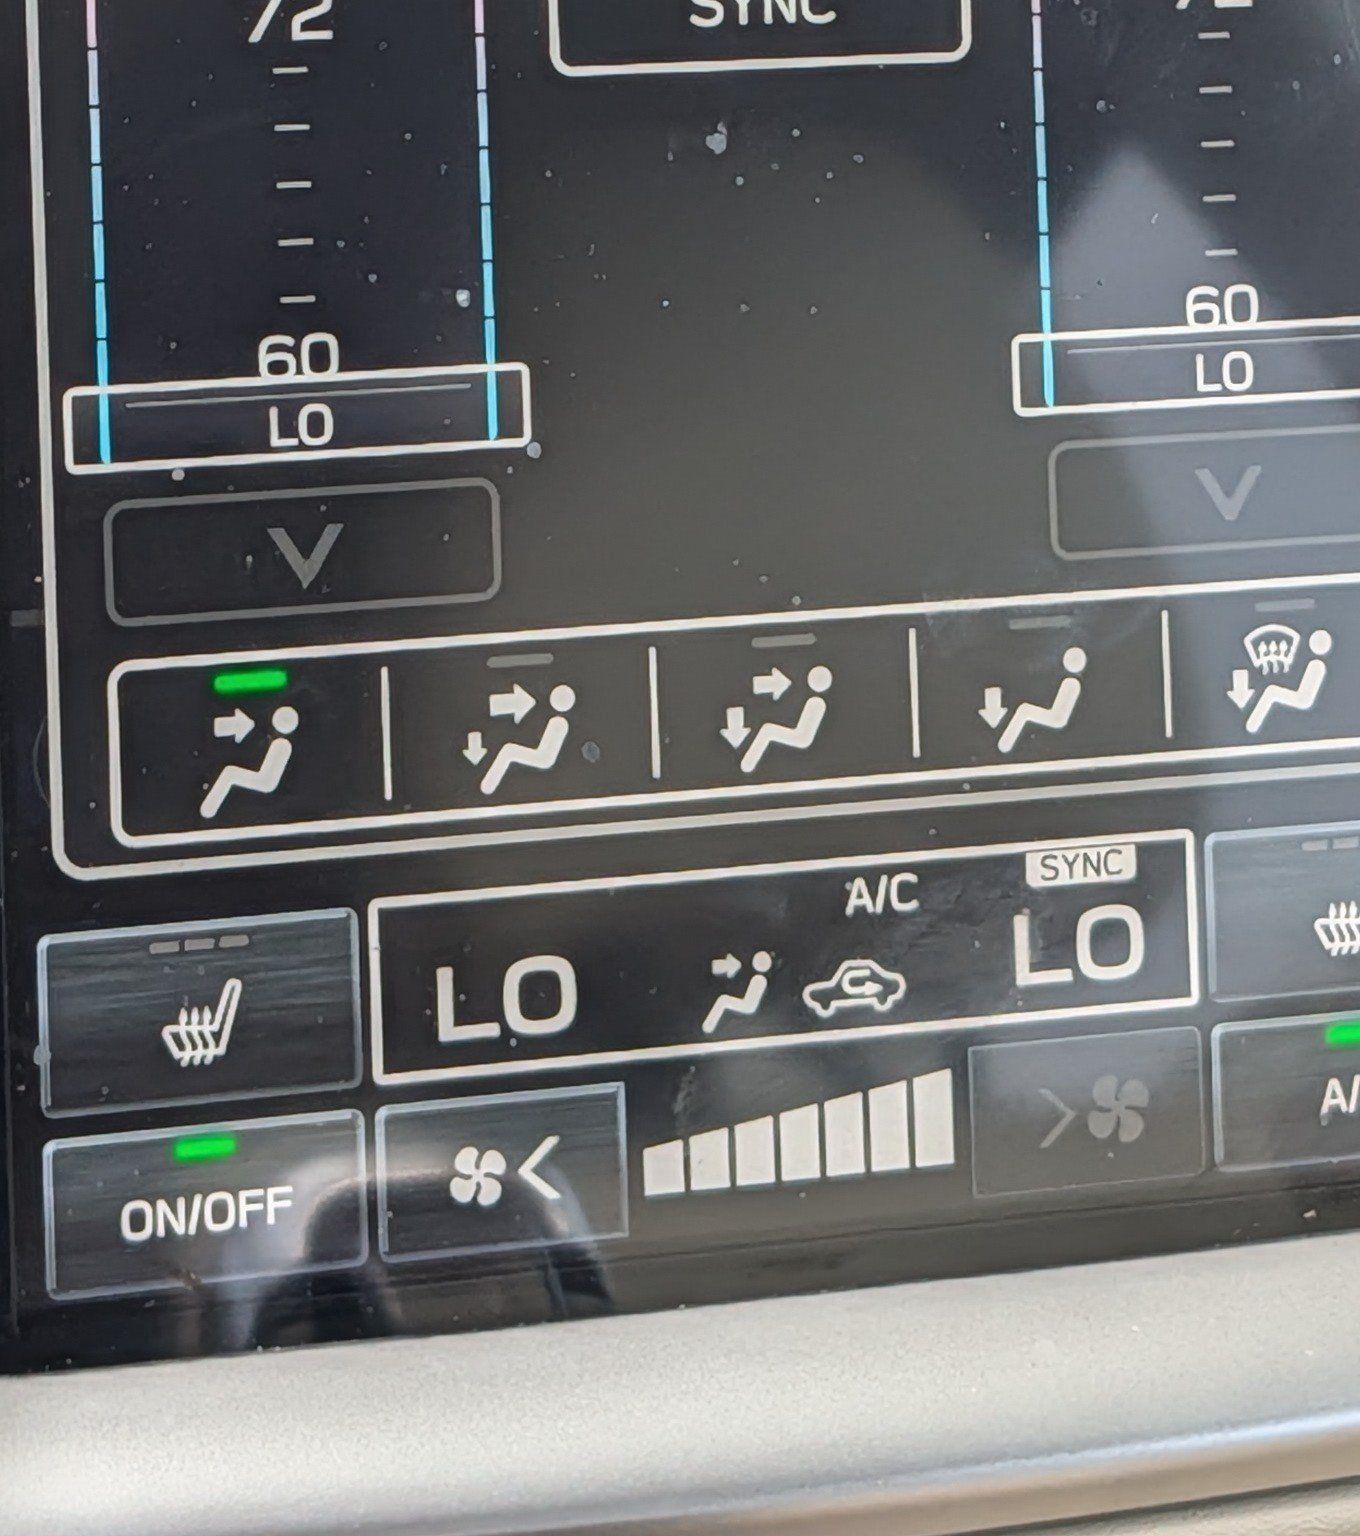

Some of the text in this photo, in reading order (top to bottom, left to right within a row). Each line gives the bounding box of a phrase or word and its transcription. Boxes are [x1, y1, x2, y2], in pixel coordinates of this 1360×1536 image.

[1185, 283, 1259, 328] 60
[257, 331, 340, 381] 60
[1195, 350, 1254, 392] LO
[268, 402, 334, 448] LO
[845, 848, 1123, 917] A/C SYNC
[1013, 904, 1145, 988] LO
[436, 954, 578, 1043] LO
[120, 1185, 294, 1243] ON/OFF
